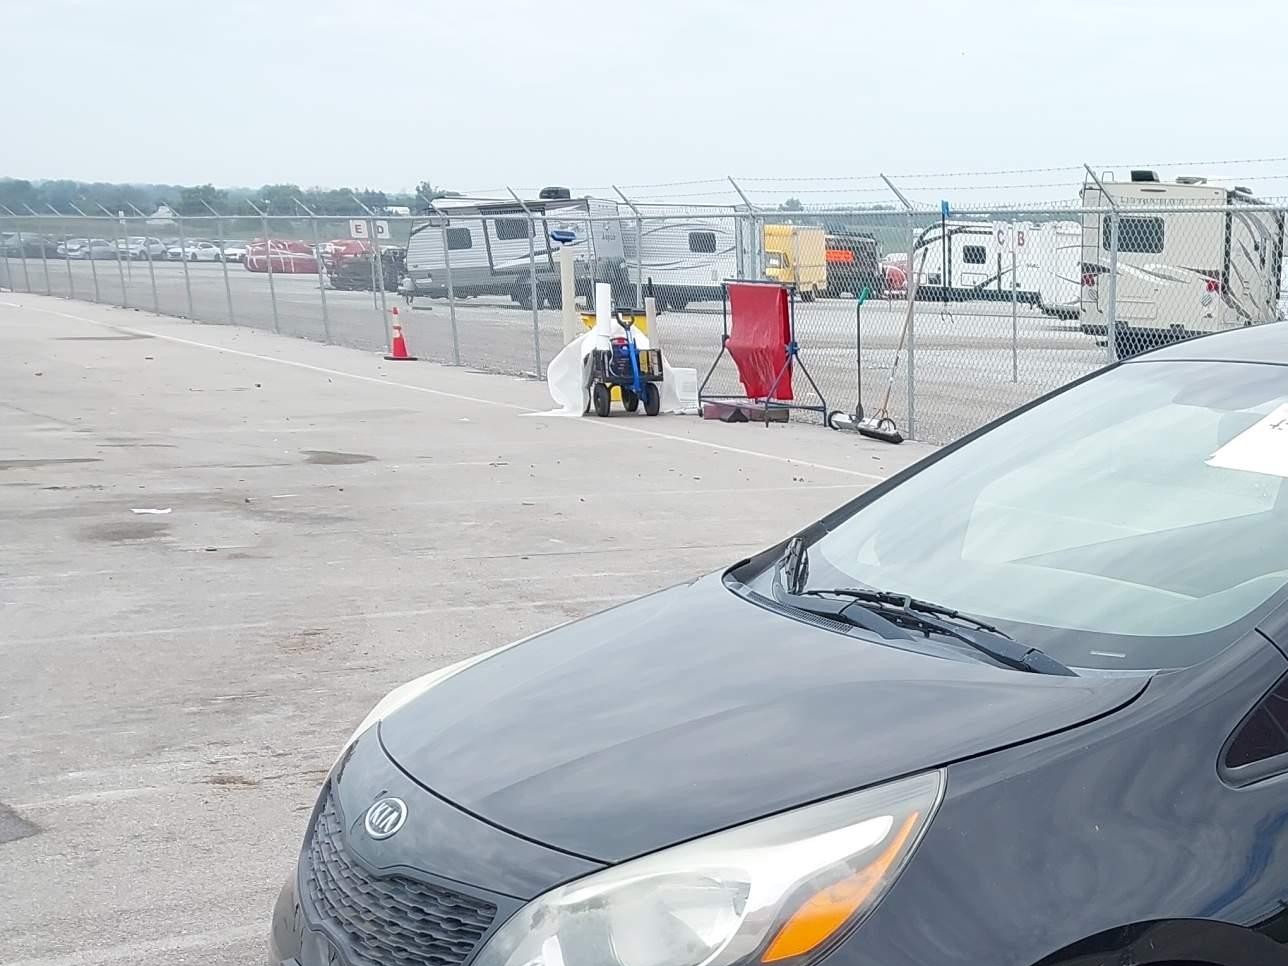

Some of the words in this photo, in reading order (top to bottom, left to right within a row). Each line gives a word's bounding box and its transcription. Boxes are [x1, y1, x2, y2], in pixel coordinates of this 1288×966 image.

[355, 224, 363, 234] E
[376, 225, 385, 235] D
[997, 229, 1005, 245] C
[1017, 231, 1025, 246] B
